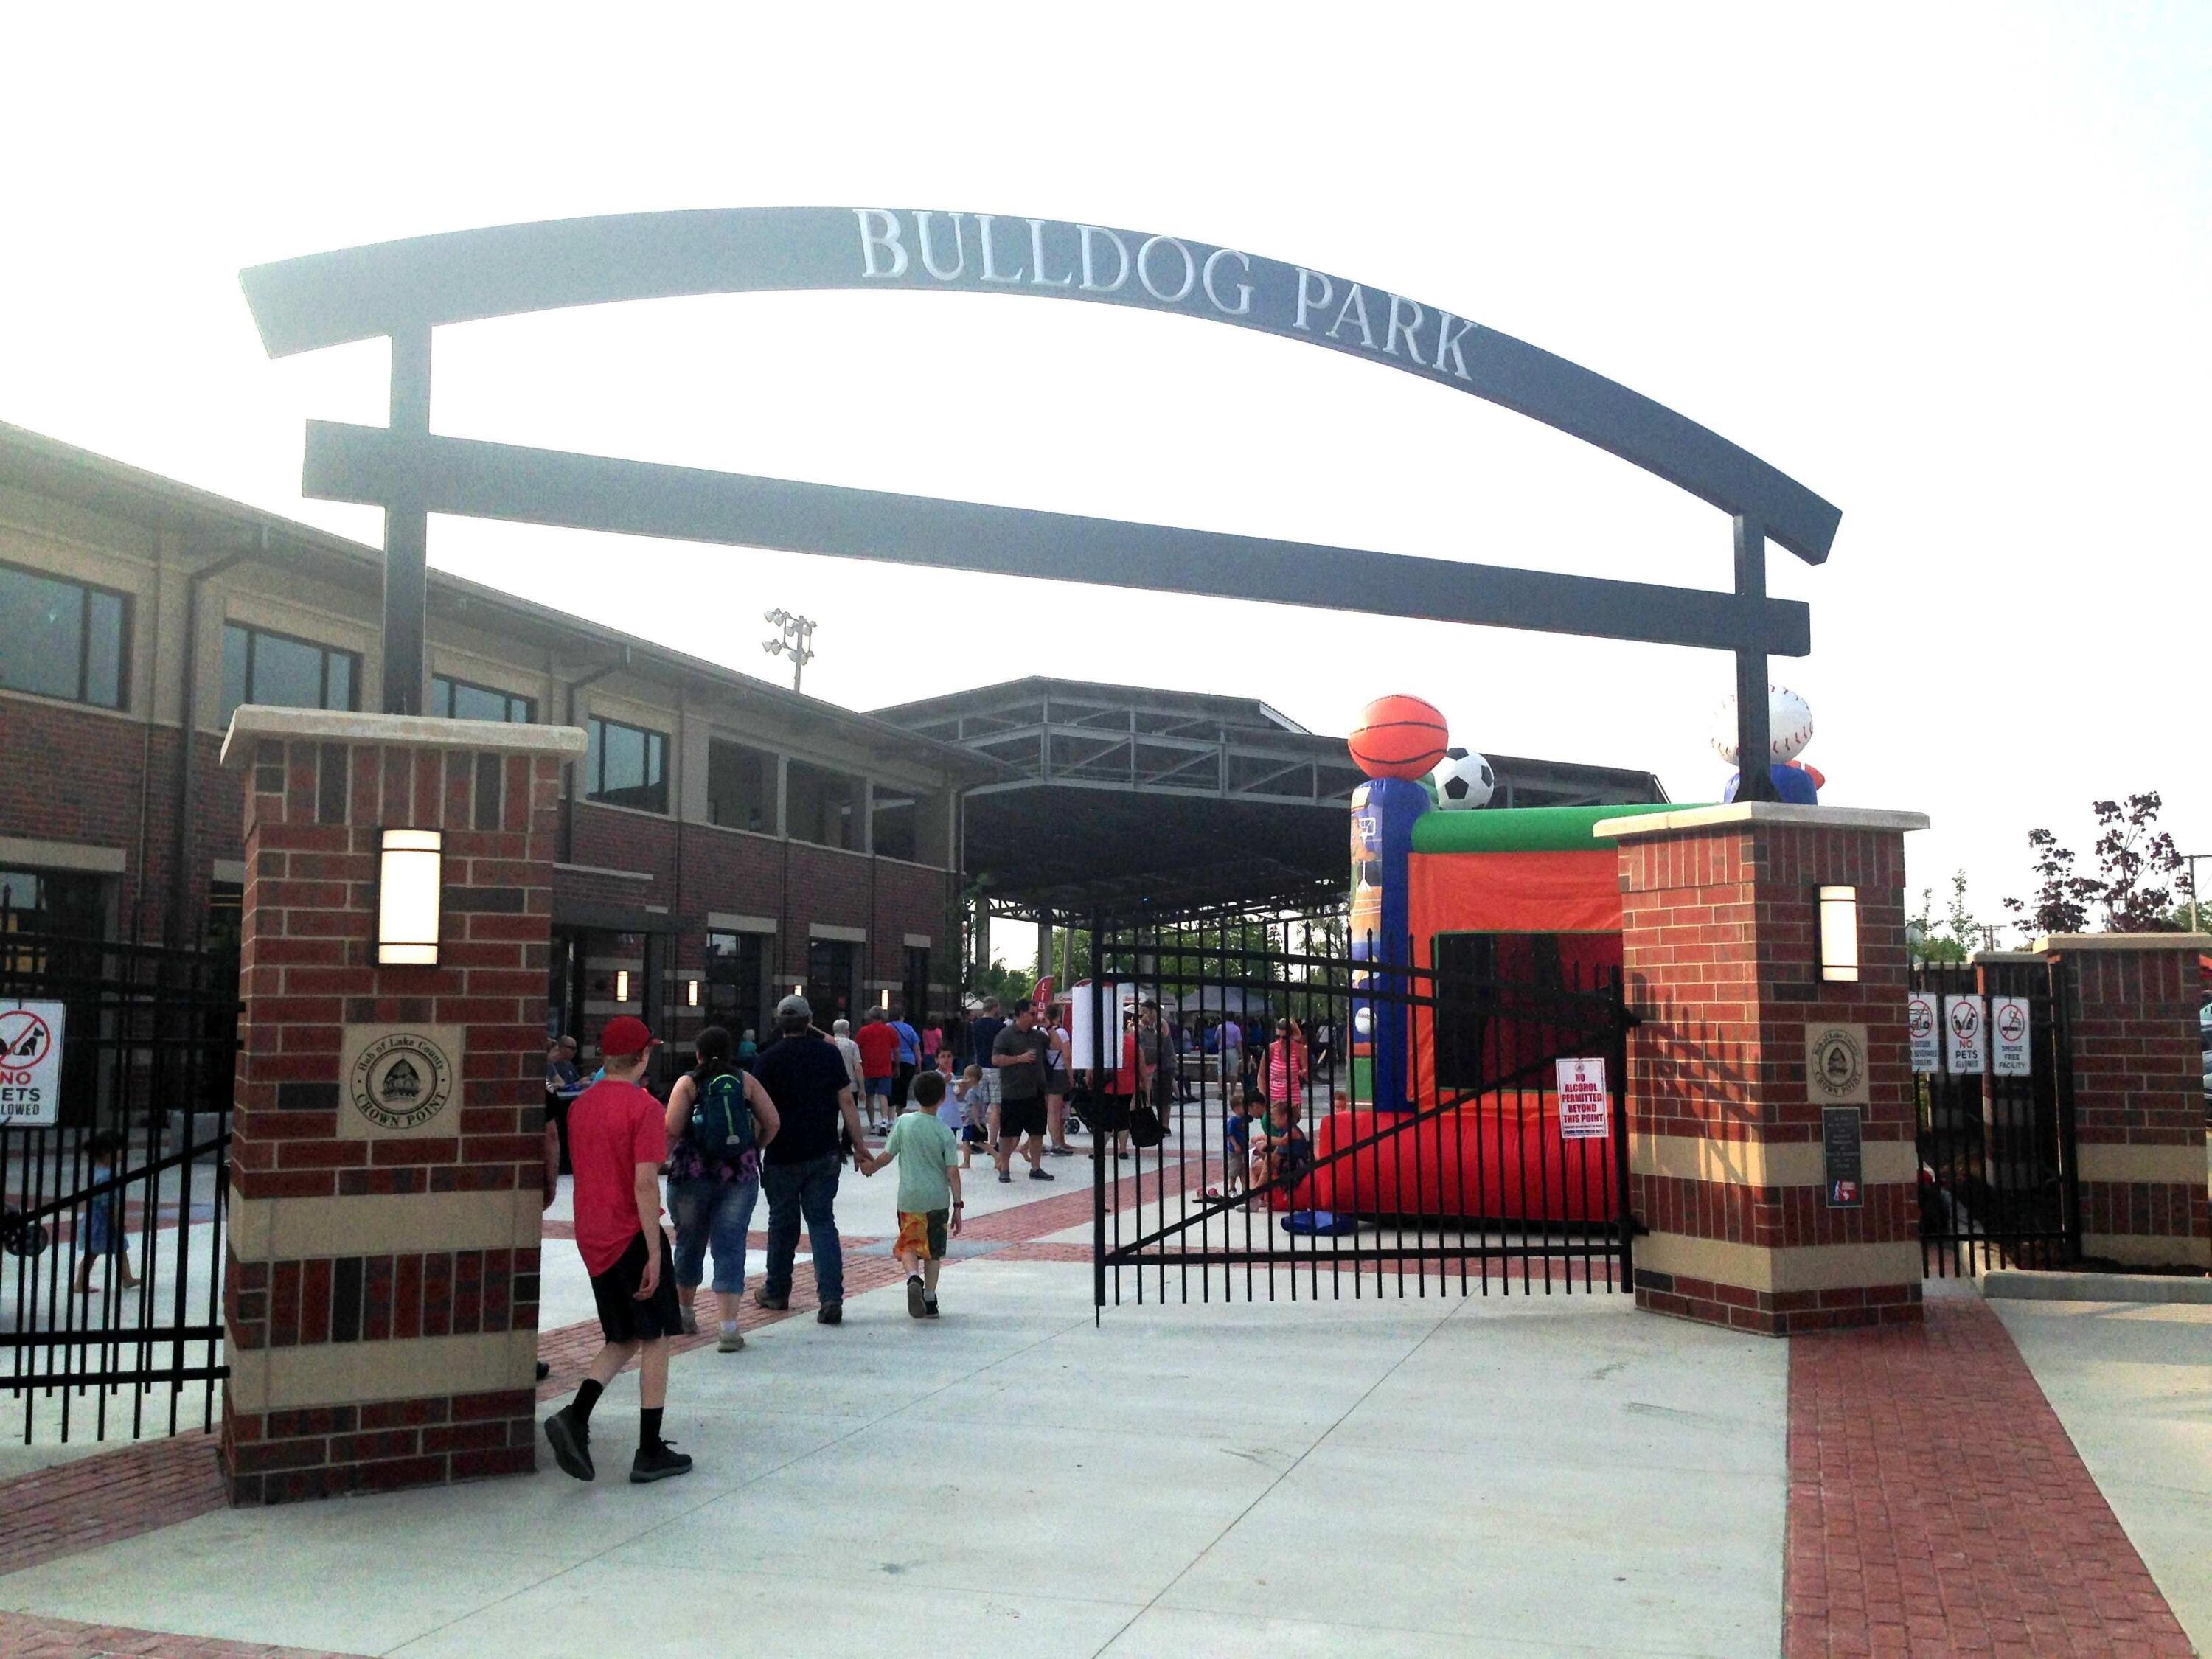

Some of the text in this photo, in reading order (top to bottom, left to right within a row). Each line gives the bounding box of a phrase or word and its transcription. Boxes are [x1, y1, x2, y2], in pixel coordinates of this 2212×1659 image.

[852, 208, 1478, 381] BULLDOG PARK
[1959, 1040, 1973, 1048] NO
[357, 1038, 444, 1071] Hub of Lake County
[1955, 1050, 1978, 1060] PETS
[0, 1071, 32, 1085] NO
[1575, 1073, 1585, 1082] NO
[1565, 1083, 1597, 1092] ALCOHOL
[2, 1088, 41, 1102] ETS
[1562, 1093, 1602, 1102] PERMITTED
[1, 1104, 40, 1116] LOWED
[356, 1091, 446, 1127] CROWN POINT
[1568, 1104, 1596, 1113] BEYOND
[1563, 1113, 1603, 1123] THIS POINT
